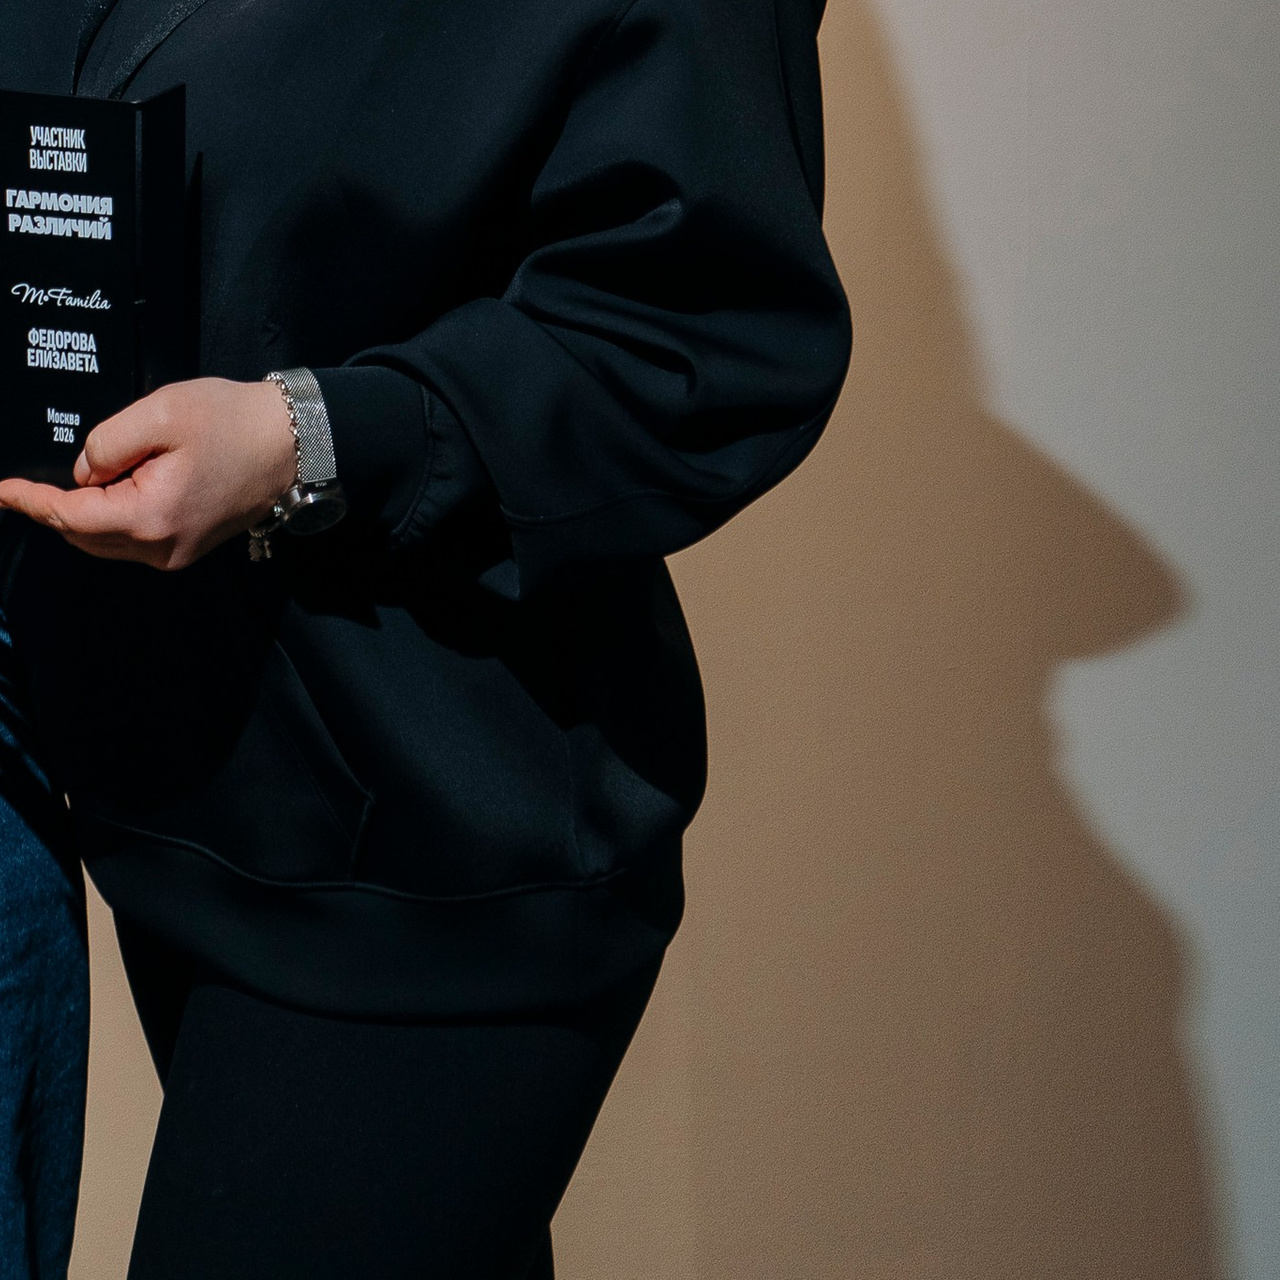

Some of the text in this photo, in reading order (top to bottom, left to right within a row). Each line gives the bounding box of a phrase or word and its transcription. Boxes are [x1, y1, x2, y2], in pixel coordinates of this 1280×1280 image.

[29, 125, 86, 150] УЧАСТНИК
[29, 148, 87, 173] ВЫСТАВКИ
[6, 189, 113, 216] ГАРМОНИЯ
[8, 214, 112, 240] РАЗЛИЧИЙ
[28, 327, 97, 353] ФЕДОРОВА
[27, 348, 99, 374] ЕЛИЗАВЕТА
[47, 408, 80, 426] Москва
[53, 427, 75, 444] 2026
